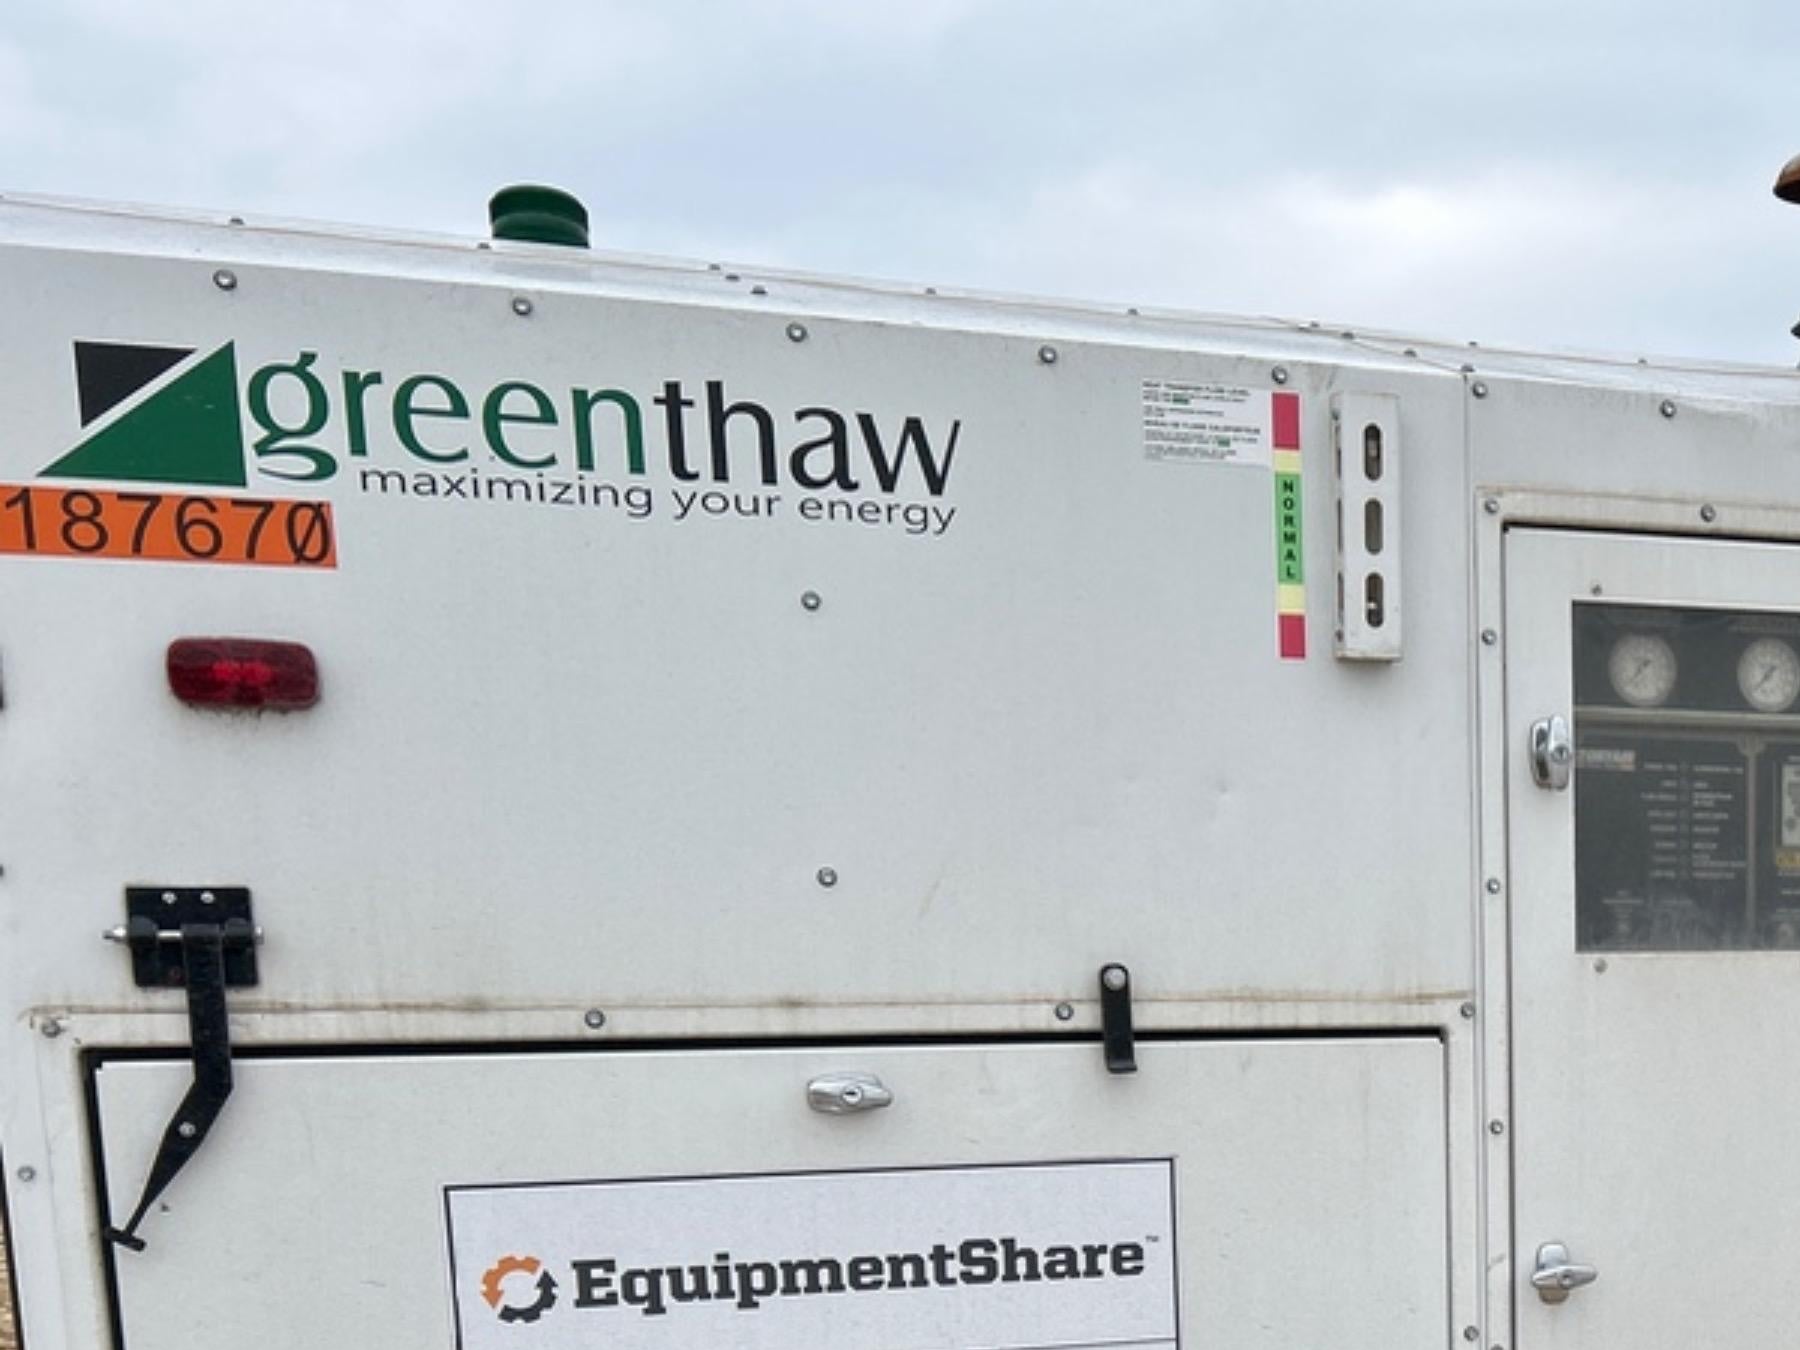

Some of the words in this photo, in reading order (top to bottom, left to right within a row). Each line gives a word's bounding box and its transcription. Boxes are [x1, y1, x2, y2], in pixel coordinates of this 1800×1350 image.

[247, 351, 961, 497] greenthaw
[4, 487, 331, 565] 187670
[360, 469, 653, 518] maximizing
[671, 489, 781, 520] your
[798, 497, 957, 535] energy
[1282, 479, 1298, 579] NORMAL
